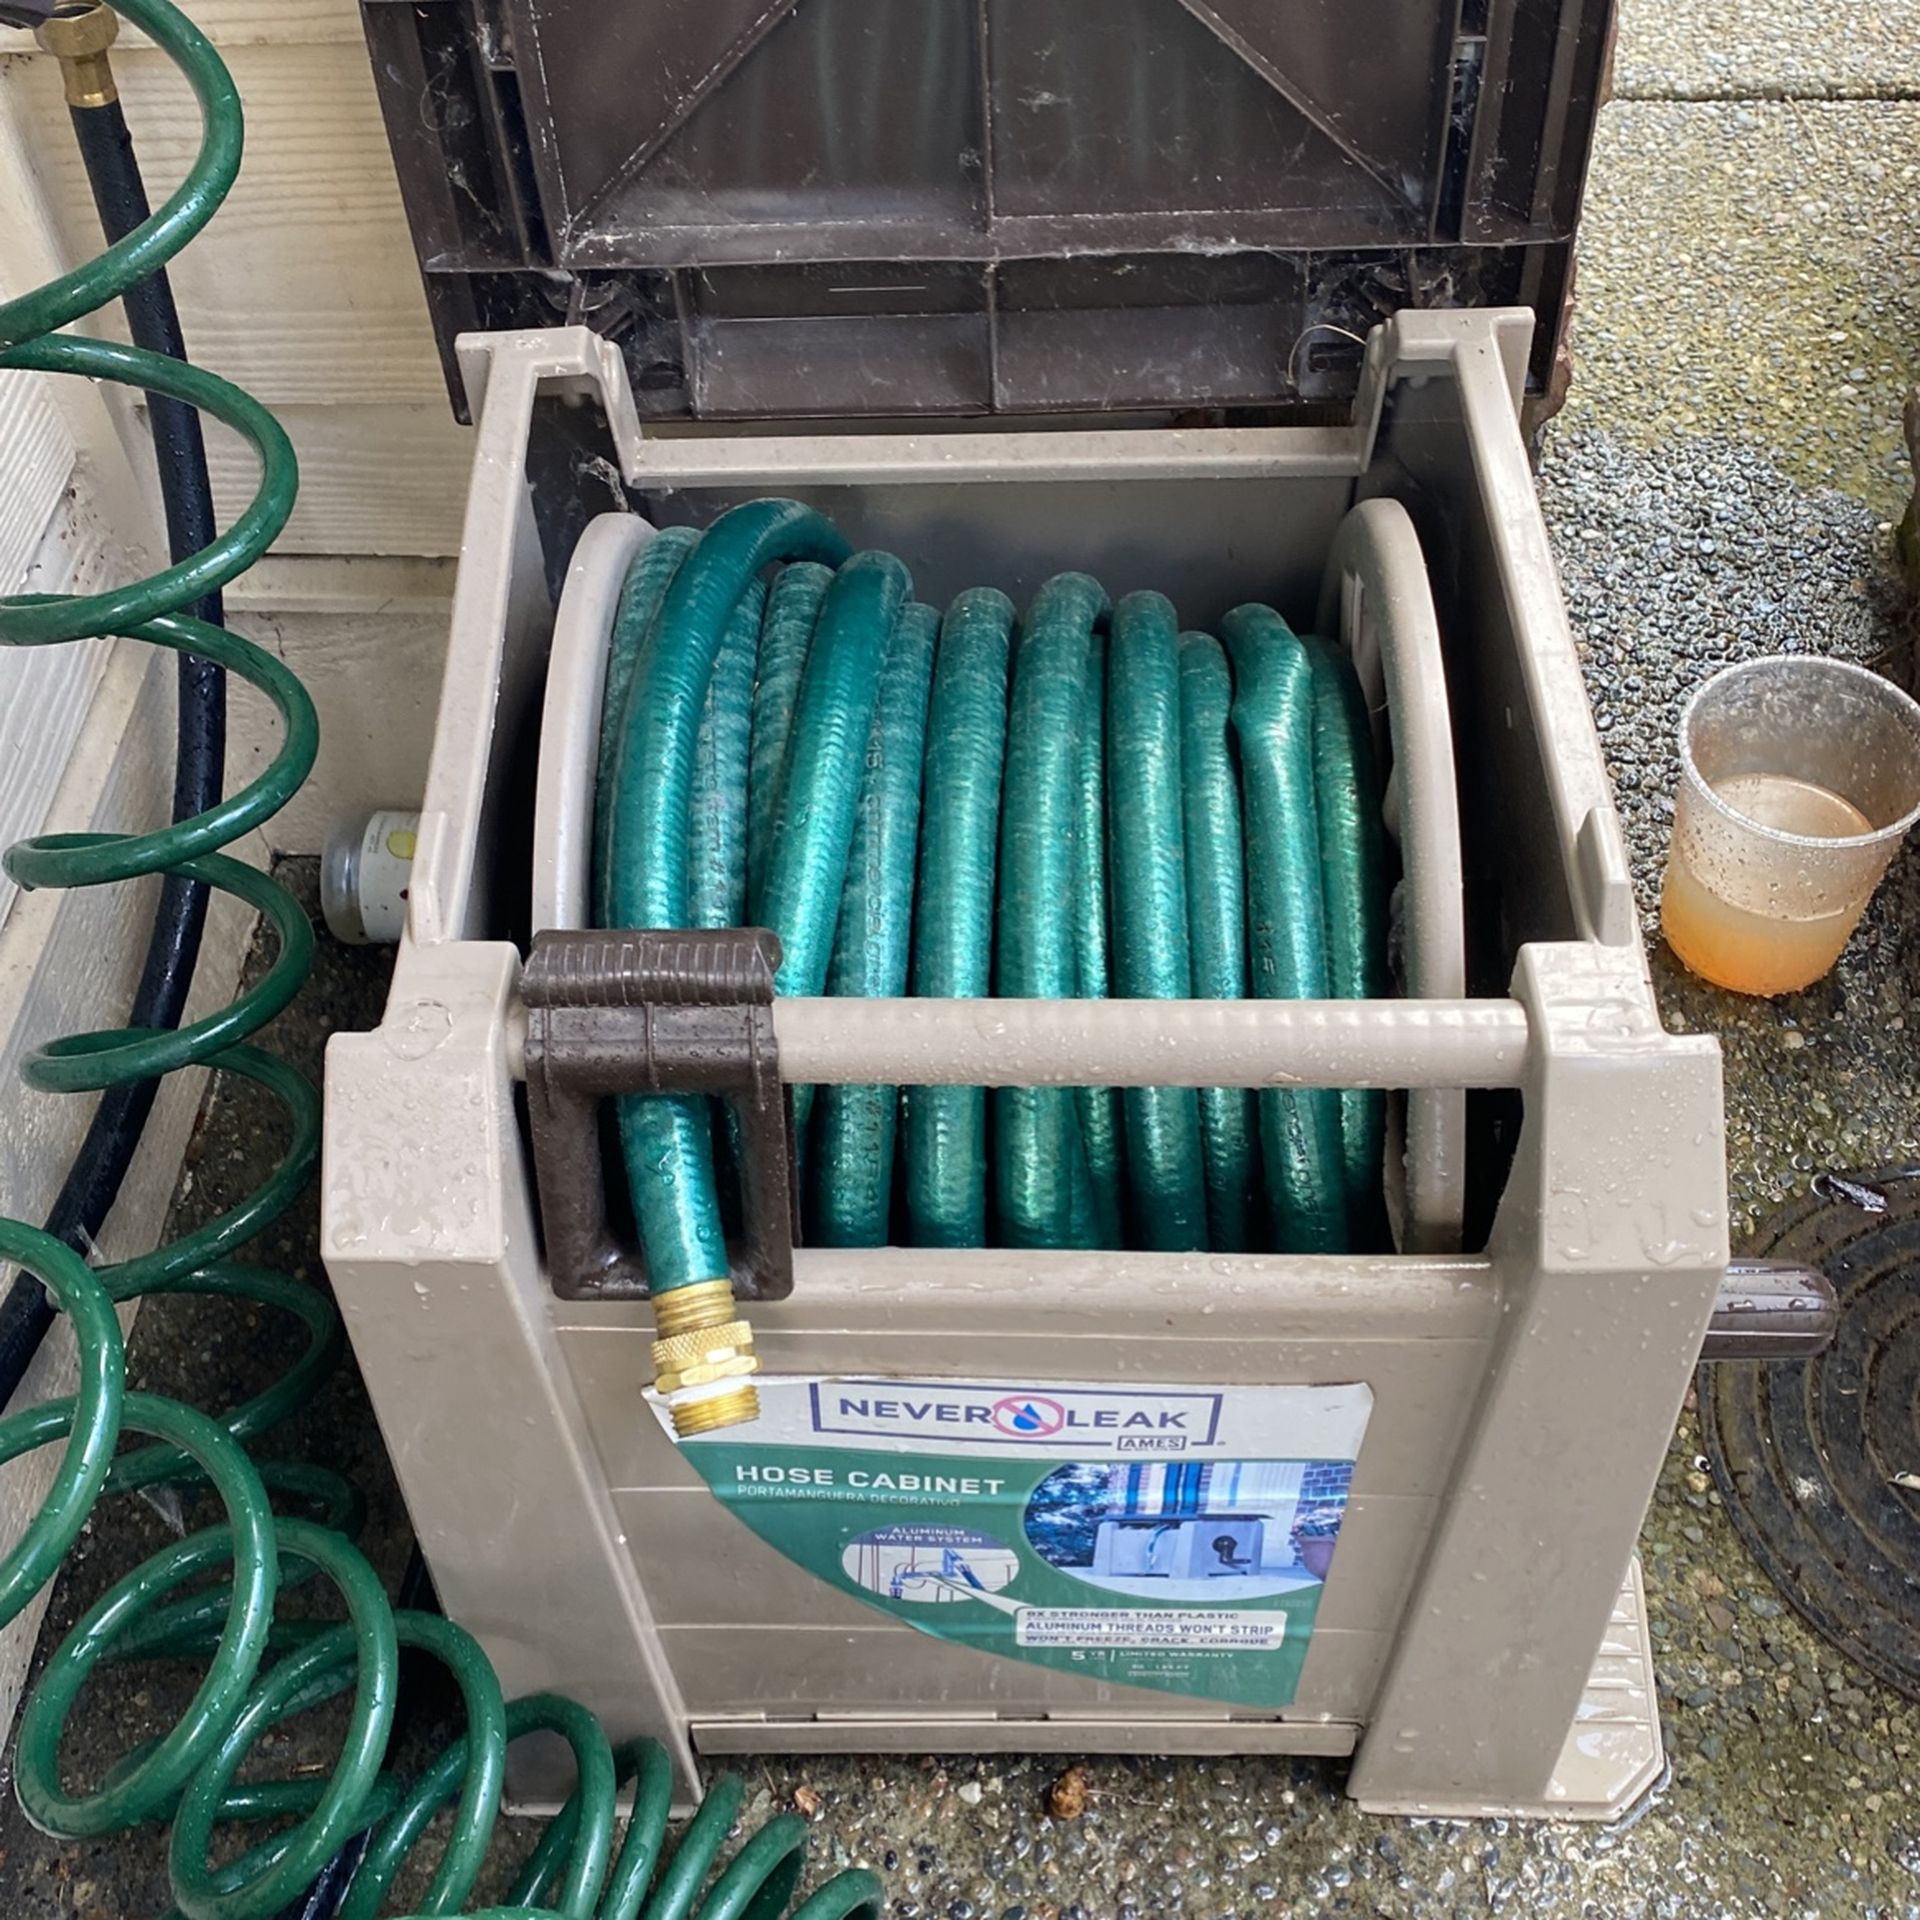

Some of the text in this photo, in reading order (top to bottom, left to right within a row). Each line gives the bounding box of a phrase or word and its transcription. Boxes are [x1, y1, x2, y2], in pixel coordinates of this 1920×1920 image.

[839, 1398, 1188, 1429] NEVER LEAK
[1124, 1438, 1180, 1448] AMES
[736, 1465, 1005, 1495] HOSE CABINET
[737, 1484, 961, 1507] PORTAMANGUERA DECORATIVO
[892, 1527, 965, 1536] ALUMINUM
[874, 1533, 983, 1544] WATER SYSTEM
[1050, 1610, 1130, 1618] STRONGER
[1135, 1611, 1173, 1619] THAN
[1178, 1612, 1239, 1620] PLASTIC
[1026, 1621, 1274, 1635] ALUMINUM THREADS WON'T STRIP
[1071, 1650, 1086, 1661] 5
